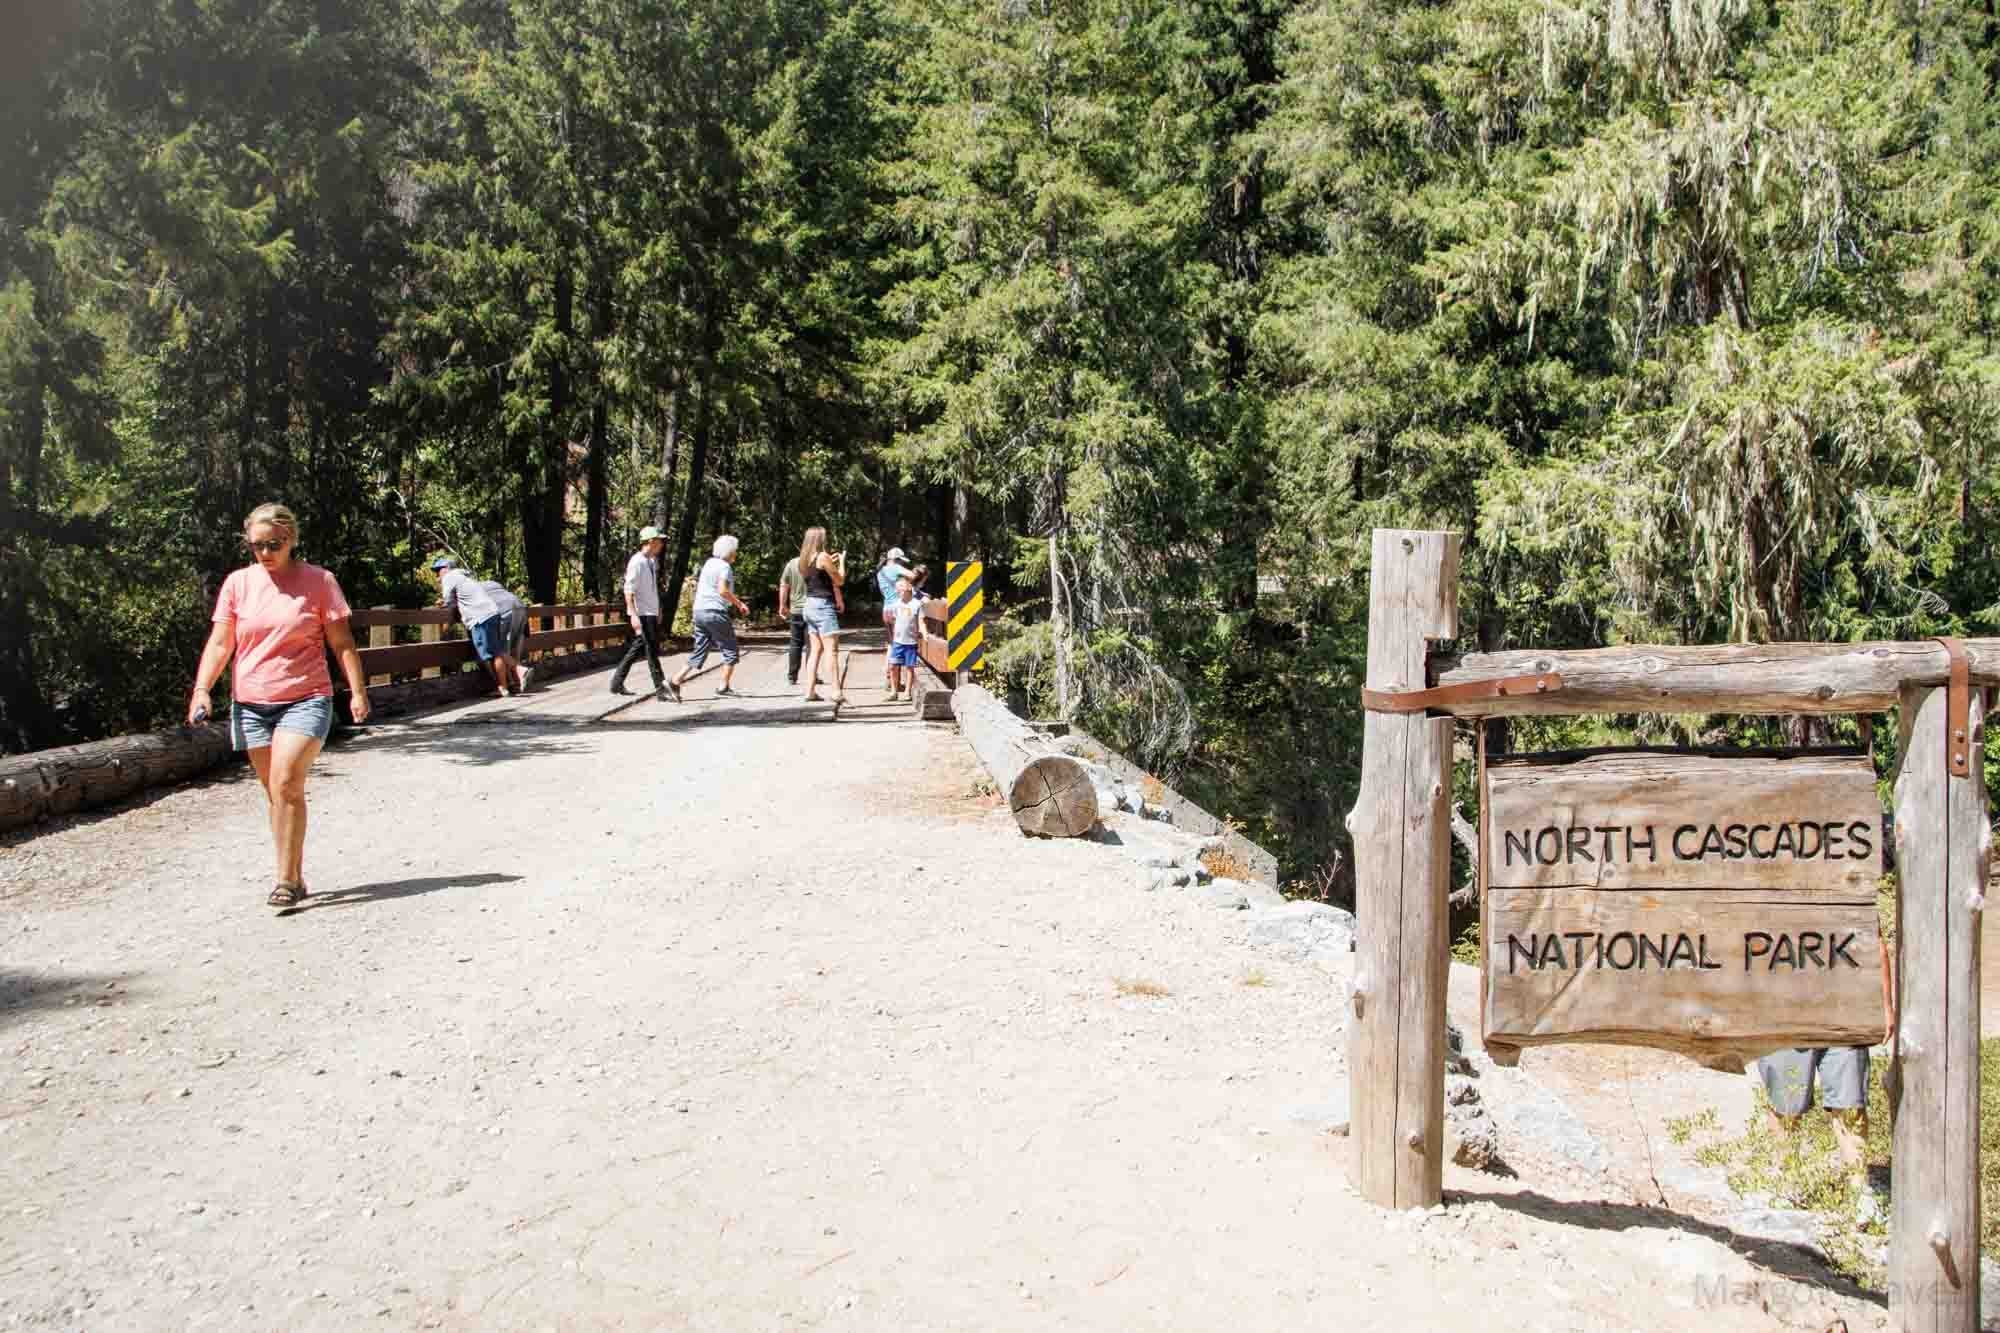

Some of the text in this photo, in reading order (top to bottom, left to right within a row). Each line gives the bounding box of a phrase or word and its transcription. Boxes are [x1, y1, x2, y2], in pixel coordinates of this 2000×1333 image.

[1503, 821, 1874, 867] NORTH CASCADES
[1507, 930, 1861, 975] NATIONAL PARK
